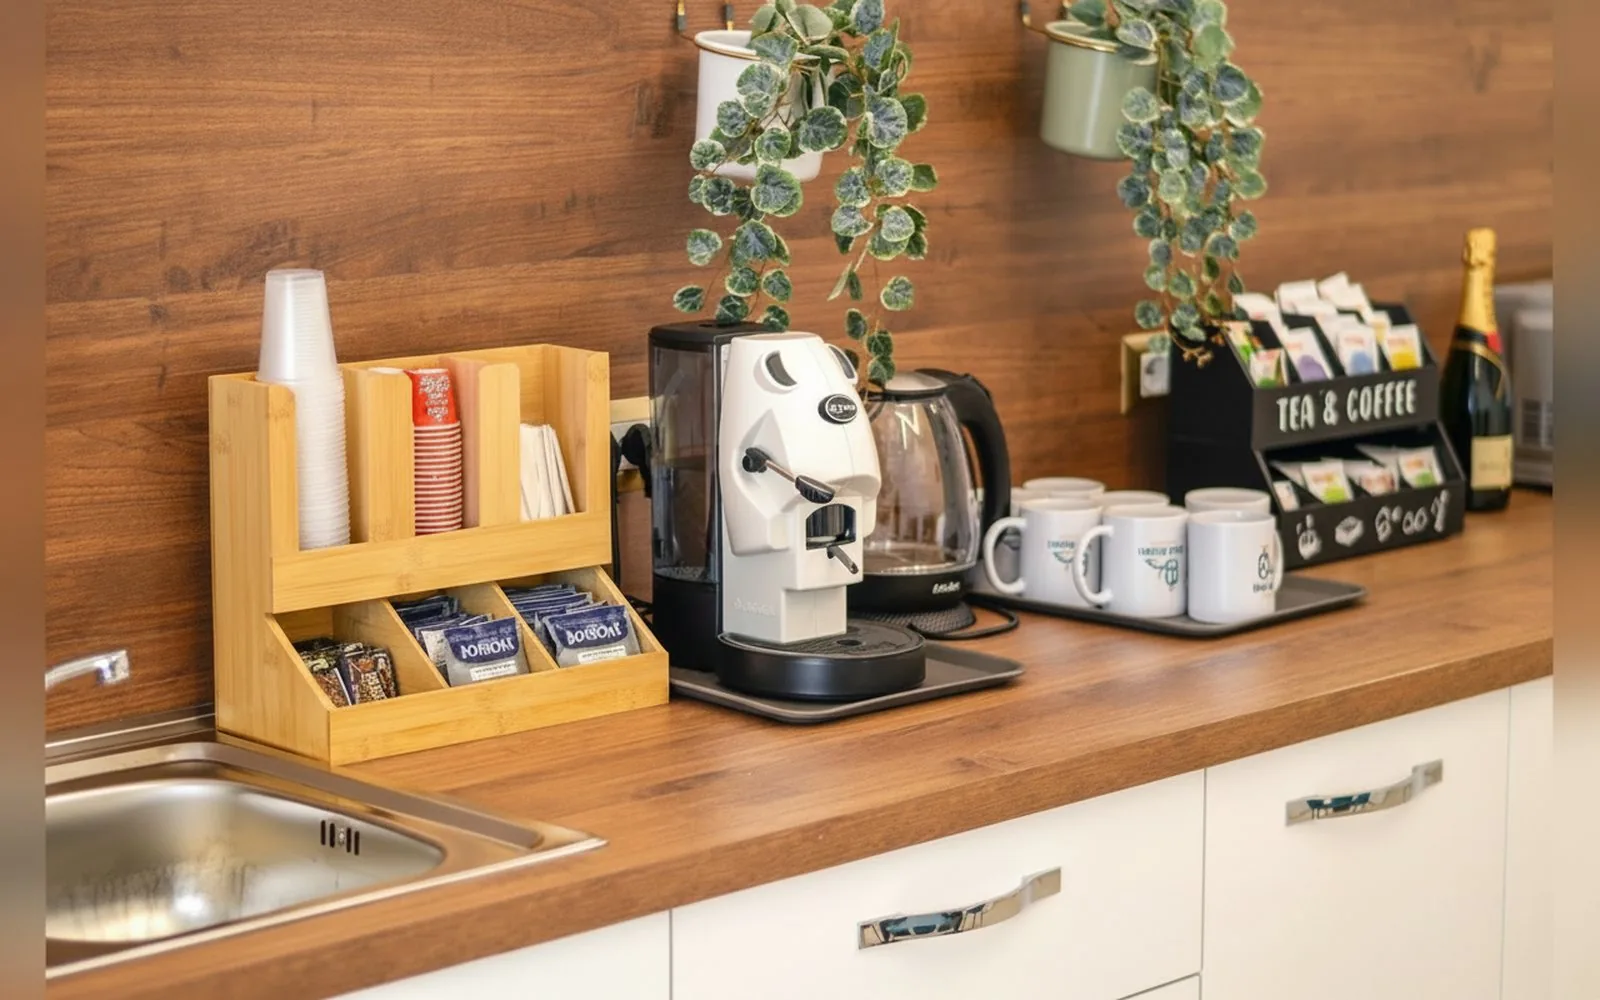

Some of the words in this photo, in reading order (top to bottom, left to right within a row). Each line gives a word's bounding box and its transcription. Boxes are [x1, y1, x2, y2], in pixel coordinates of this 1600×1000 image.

[1276, 394, 1315, 432] TEA
[1323, 390, 1339, 426] &
[1347, 379, 1417, 423] COFFEE
